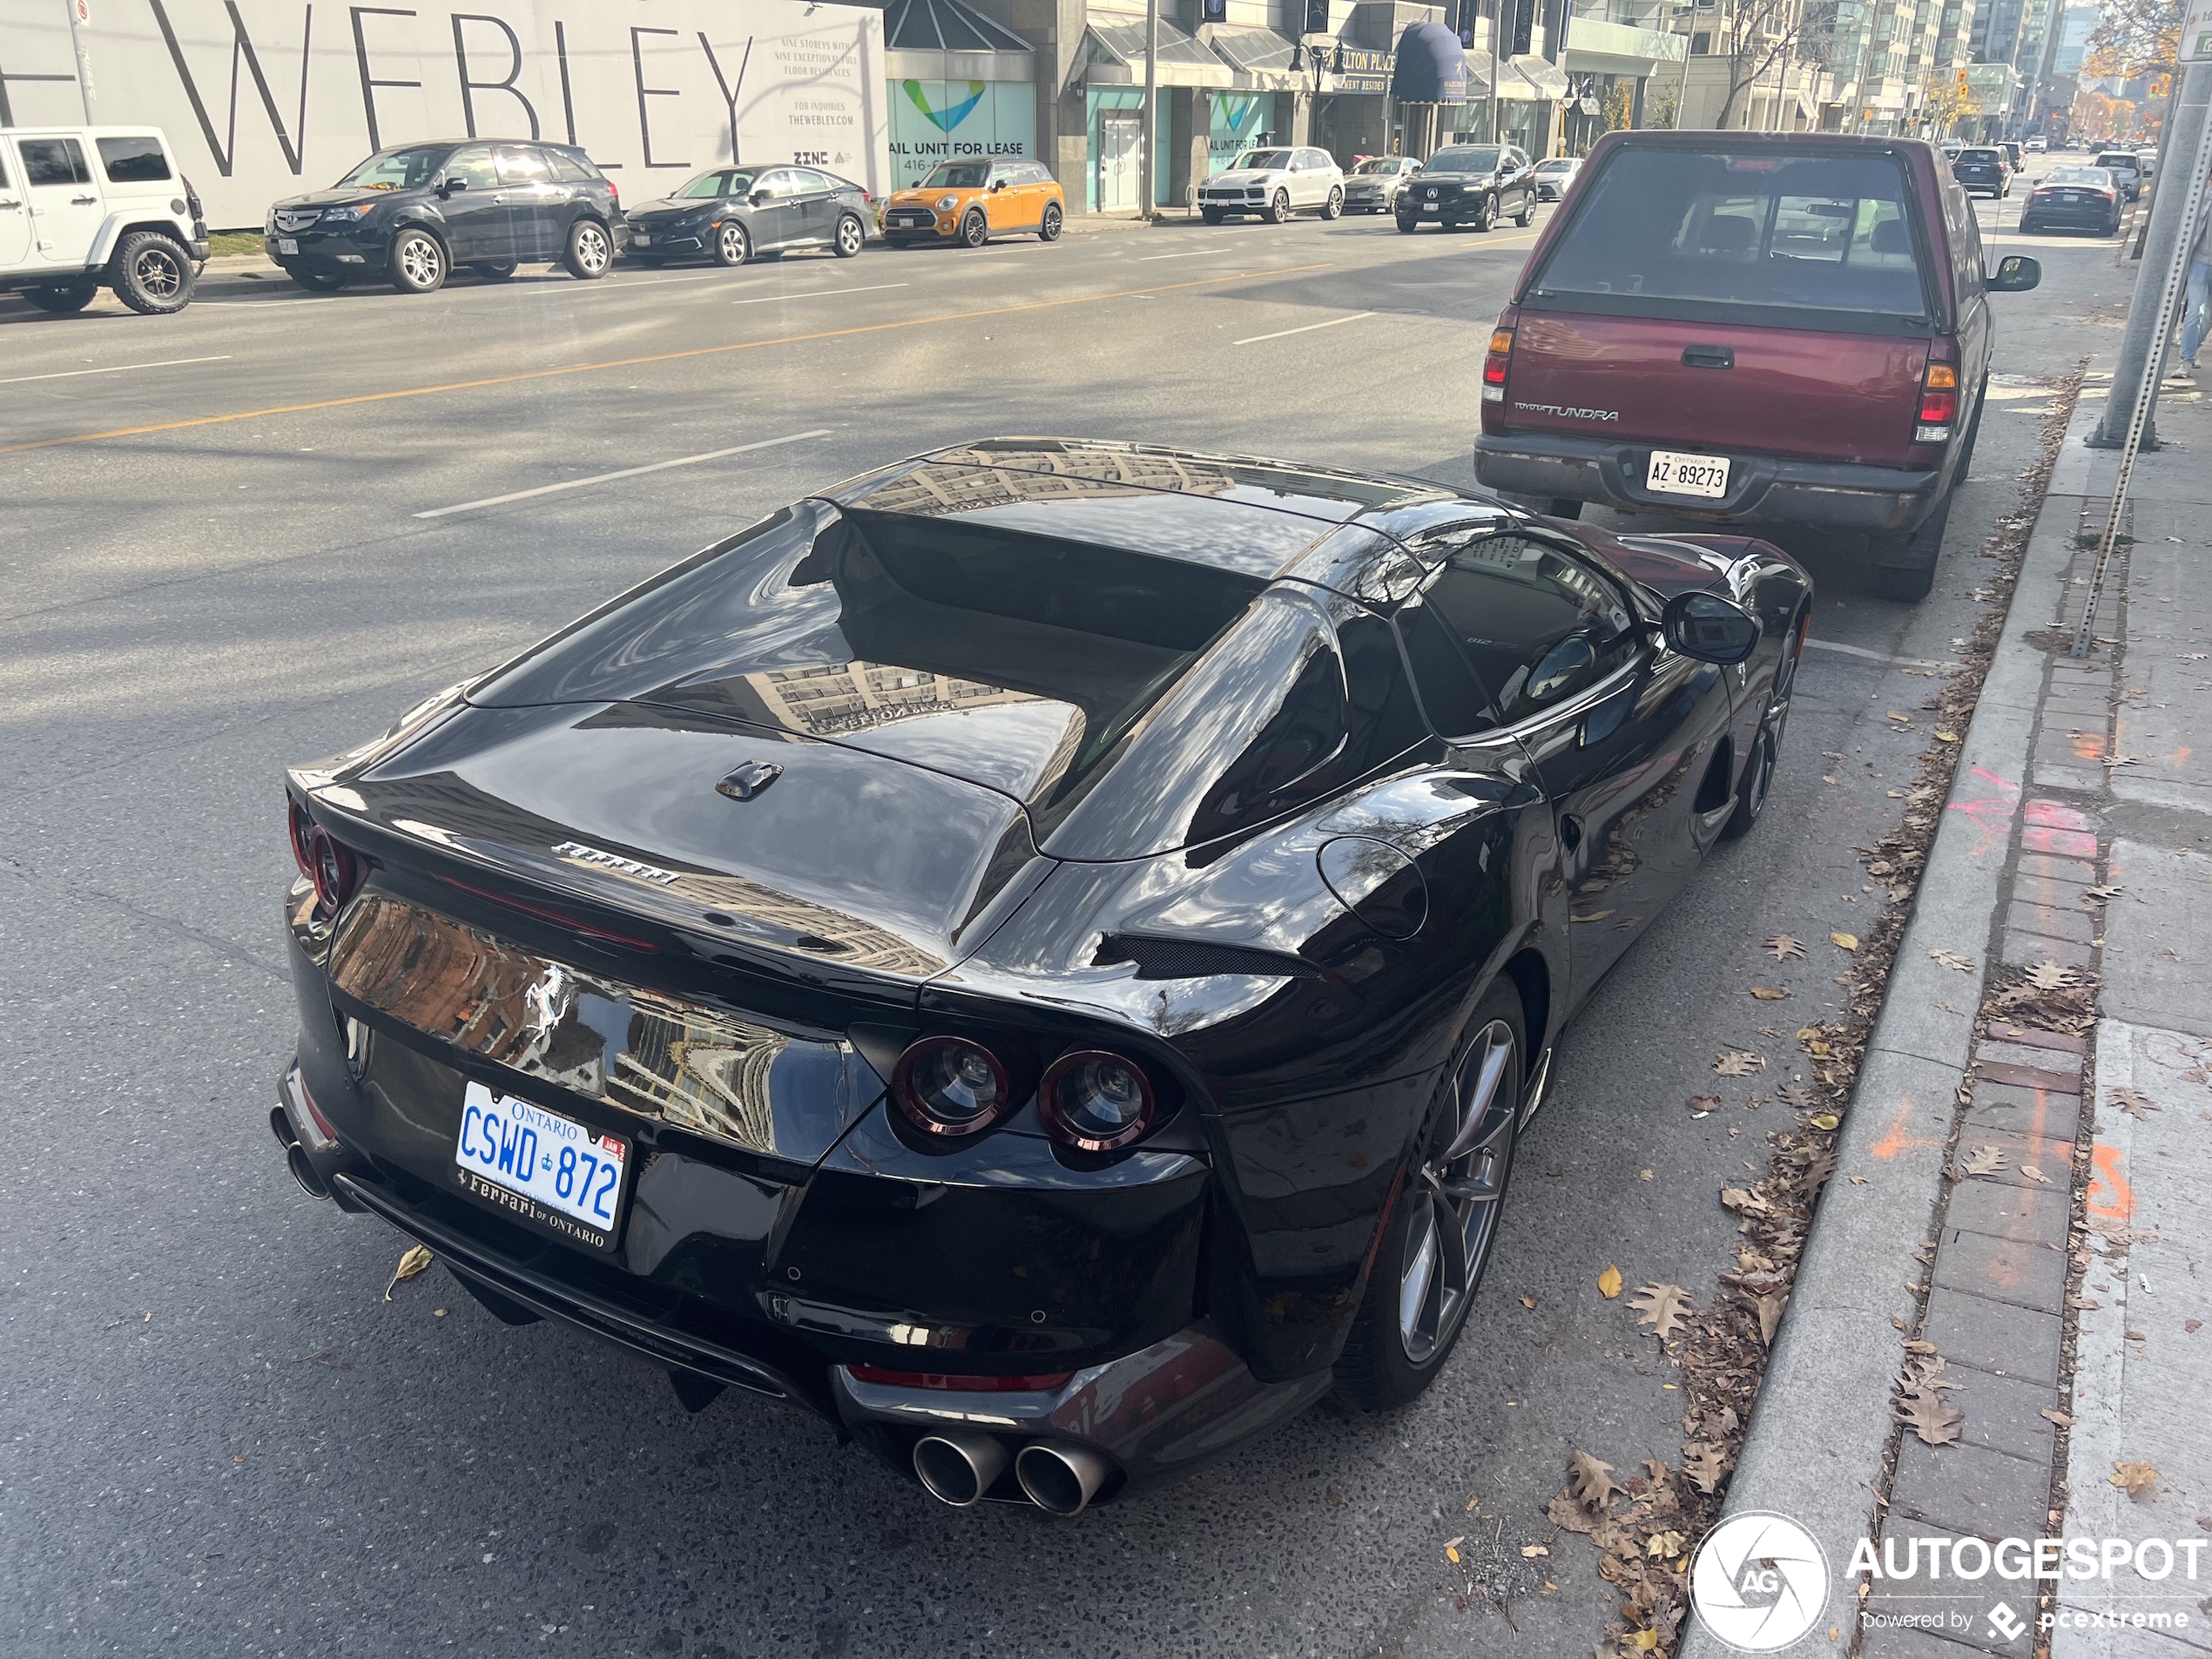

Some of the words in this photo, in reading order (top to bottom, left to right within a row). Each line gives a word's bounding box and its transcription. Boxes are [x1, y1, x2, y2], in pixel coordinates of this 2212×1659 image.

[799, 39, 831, 50] STOREYS
[793, 52, 840, 64] EXCEPTIONAL
[1371, 53, 1396, 71] PLACE
[785, 65, 808, 75] FLOOR
[810, 66, 850, 77] RESIDENCES
[788, 115, 853, 125] THEWEBLEY.COM
[915, 143, 949, 154] UNIT
[954, 143, 982, 155] FOR
[987, 143, 1023, 154] LEASE
[1220, 140, 1235, 151] UNIT
[1236, 140, 1248, 151] FOR
[793, 152, 829, 165] ZINC
[1514, 402, 1546, 412] TOYOTA
[1544, 405, 1619, 421] TUNDRA
[1675, 456, 1706, 465] ONTARIO
[1651, 462, 1670, 481] AZ
[1678, 465, 1724, 488] 89273
[512, 1102, 577, 1141] ONTARIO
[604, 1141, 617, 1153] JAN
[462, 1105, 538, 1183] CSWD
[555, 1146, 617, 1220] 872
[469, 1173, 536, 1218] Ferrari
[536, 1211, 547, 1220] OF
[549, 1215, 604, 1248] ONTARIO
